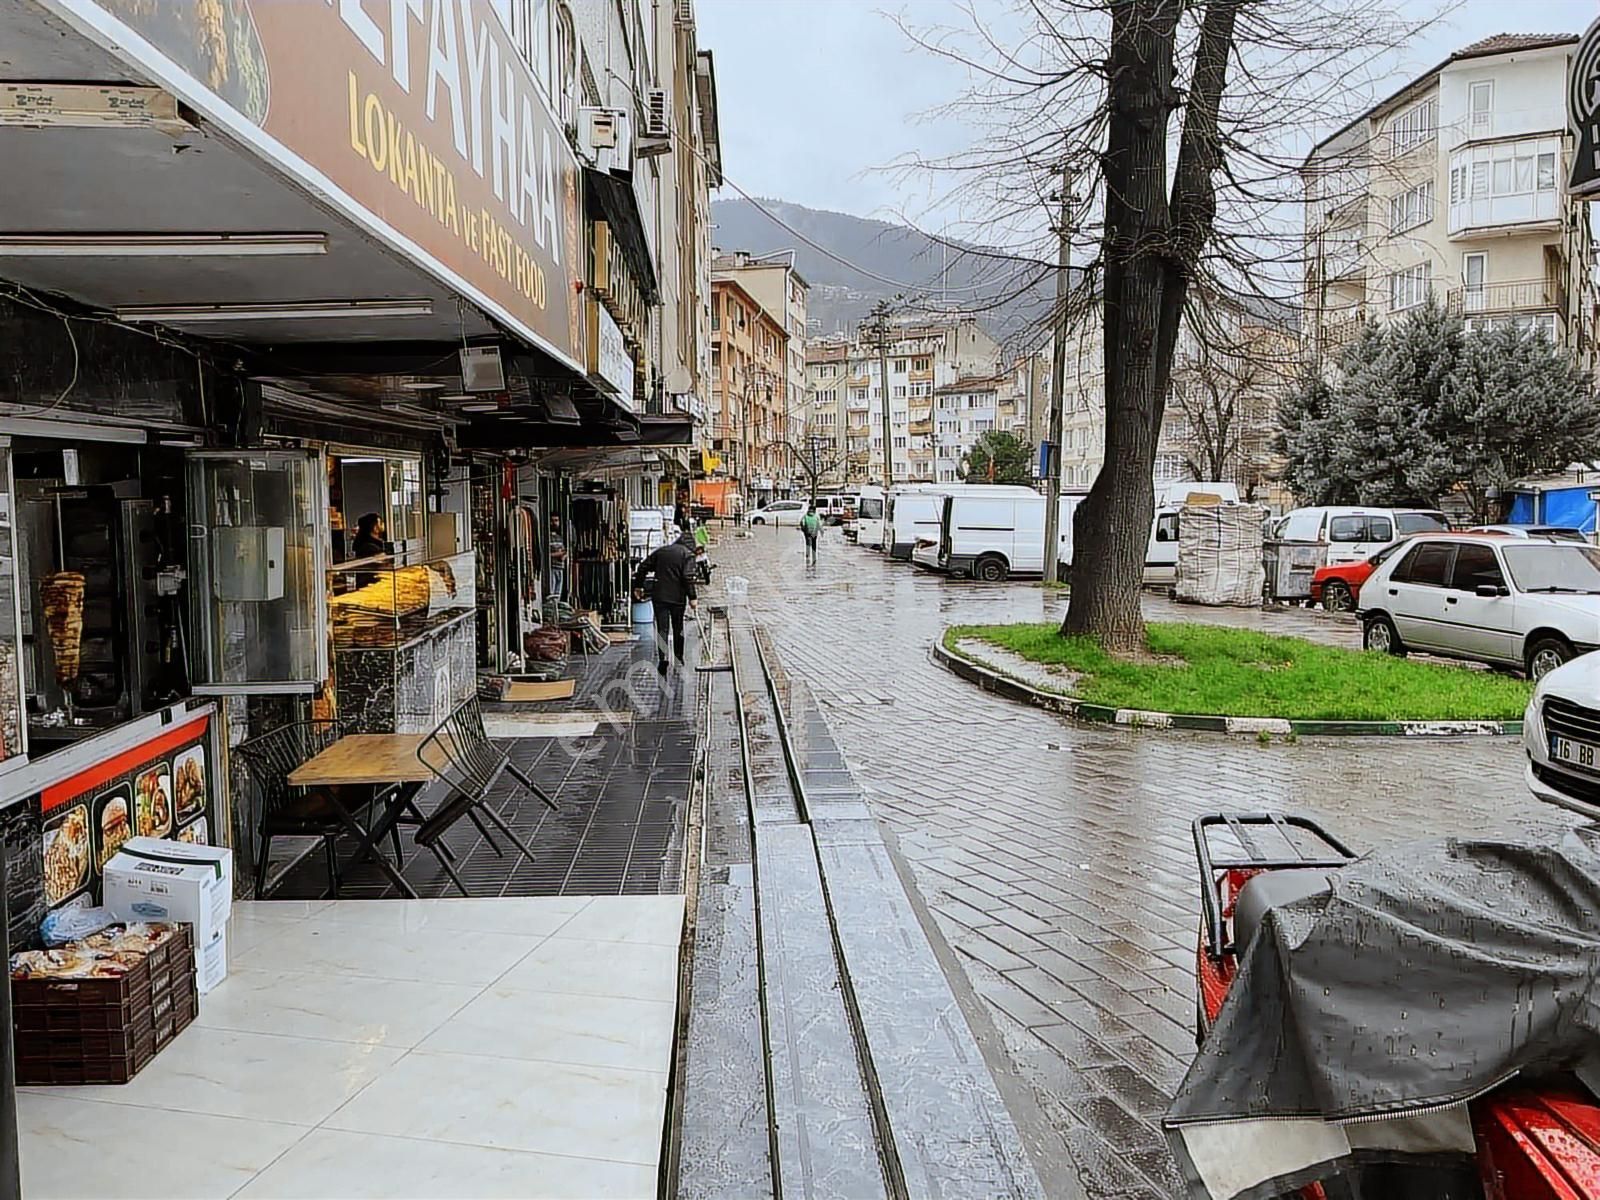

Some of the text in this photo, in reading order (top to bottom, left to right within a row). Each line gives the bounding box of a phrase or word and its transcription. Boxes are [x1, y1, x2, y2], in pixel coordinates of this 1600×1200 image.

[348, 69, 460, 237] LOKANTA
[481, 207, 513, 283] FAST
[515, 244, 546, 311] FOOD
[1559, 739, 1570, 760] 16
